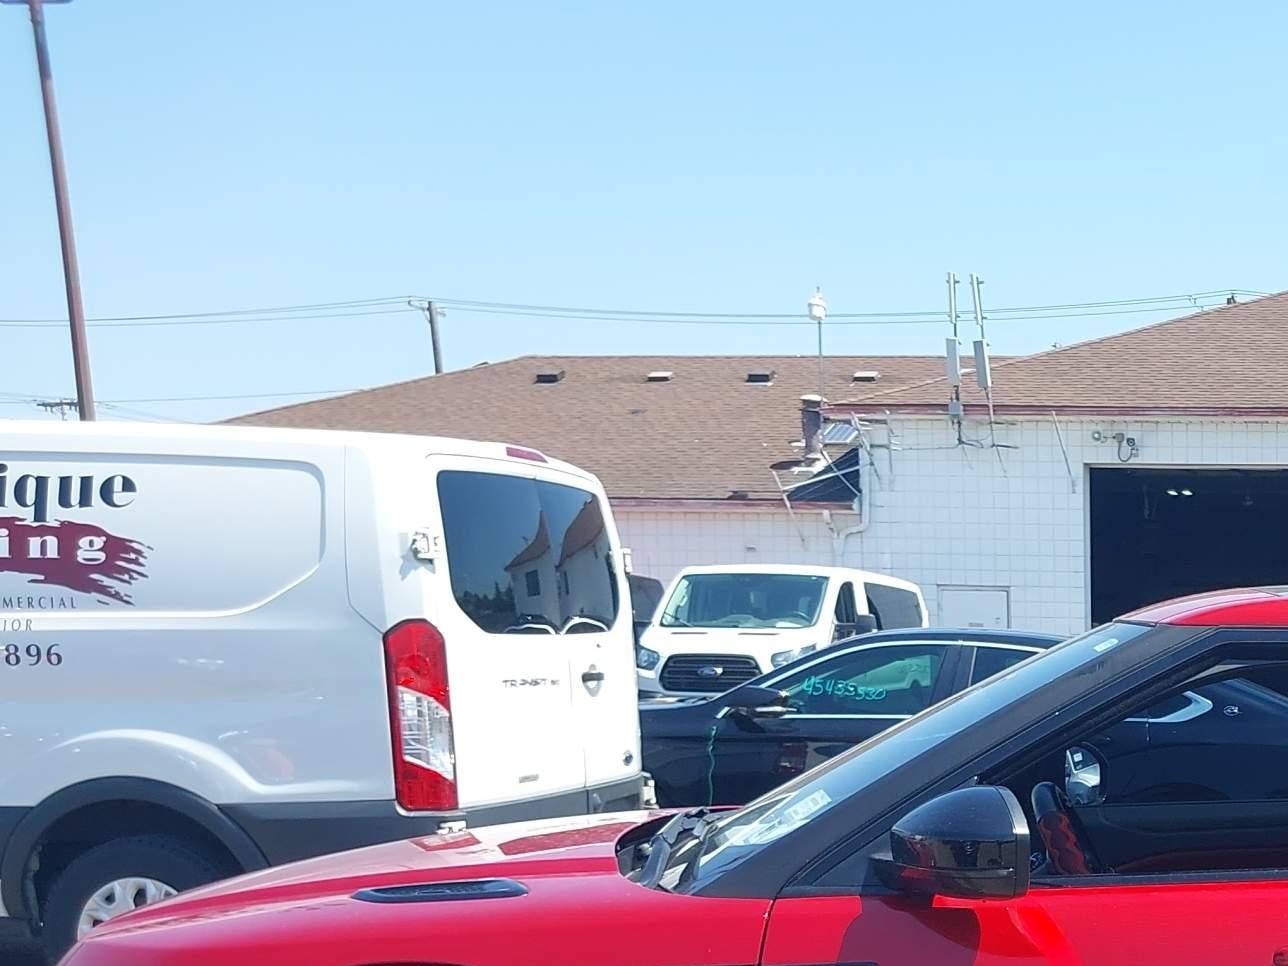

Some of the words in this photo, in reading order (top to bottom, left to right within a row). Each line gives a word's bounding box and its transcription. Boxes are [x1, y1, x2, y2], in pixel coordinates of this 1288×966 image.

[0, 528, 106, 565] ing
[2, 596, 77, 609] MERCIAL
[3, 618, 33, 632] IOR
[5, 643, 63, 666] 896
